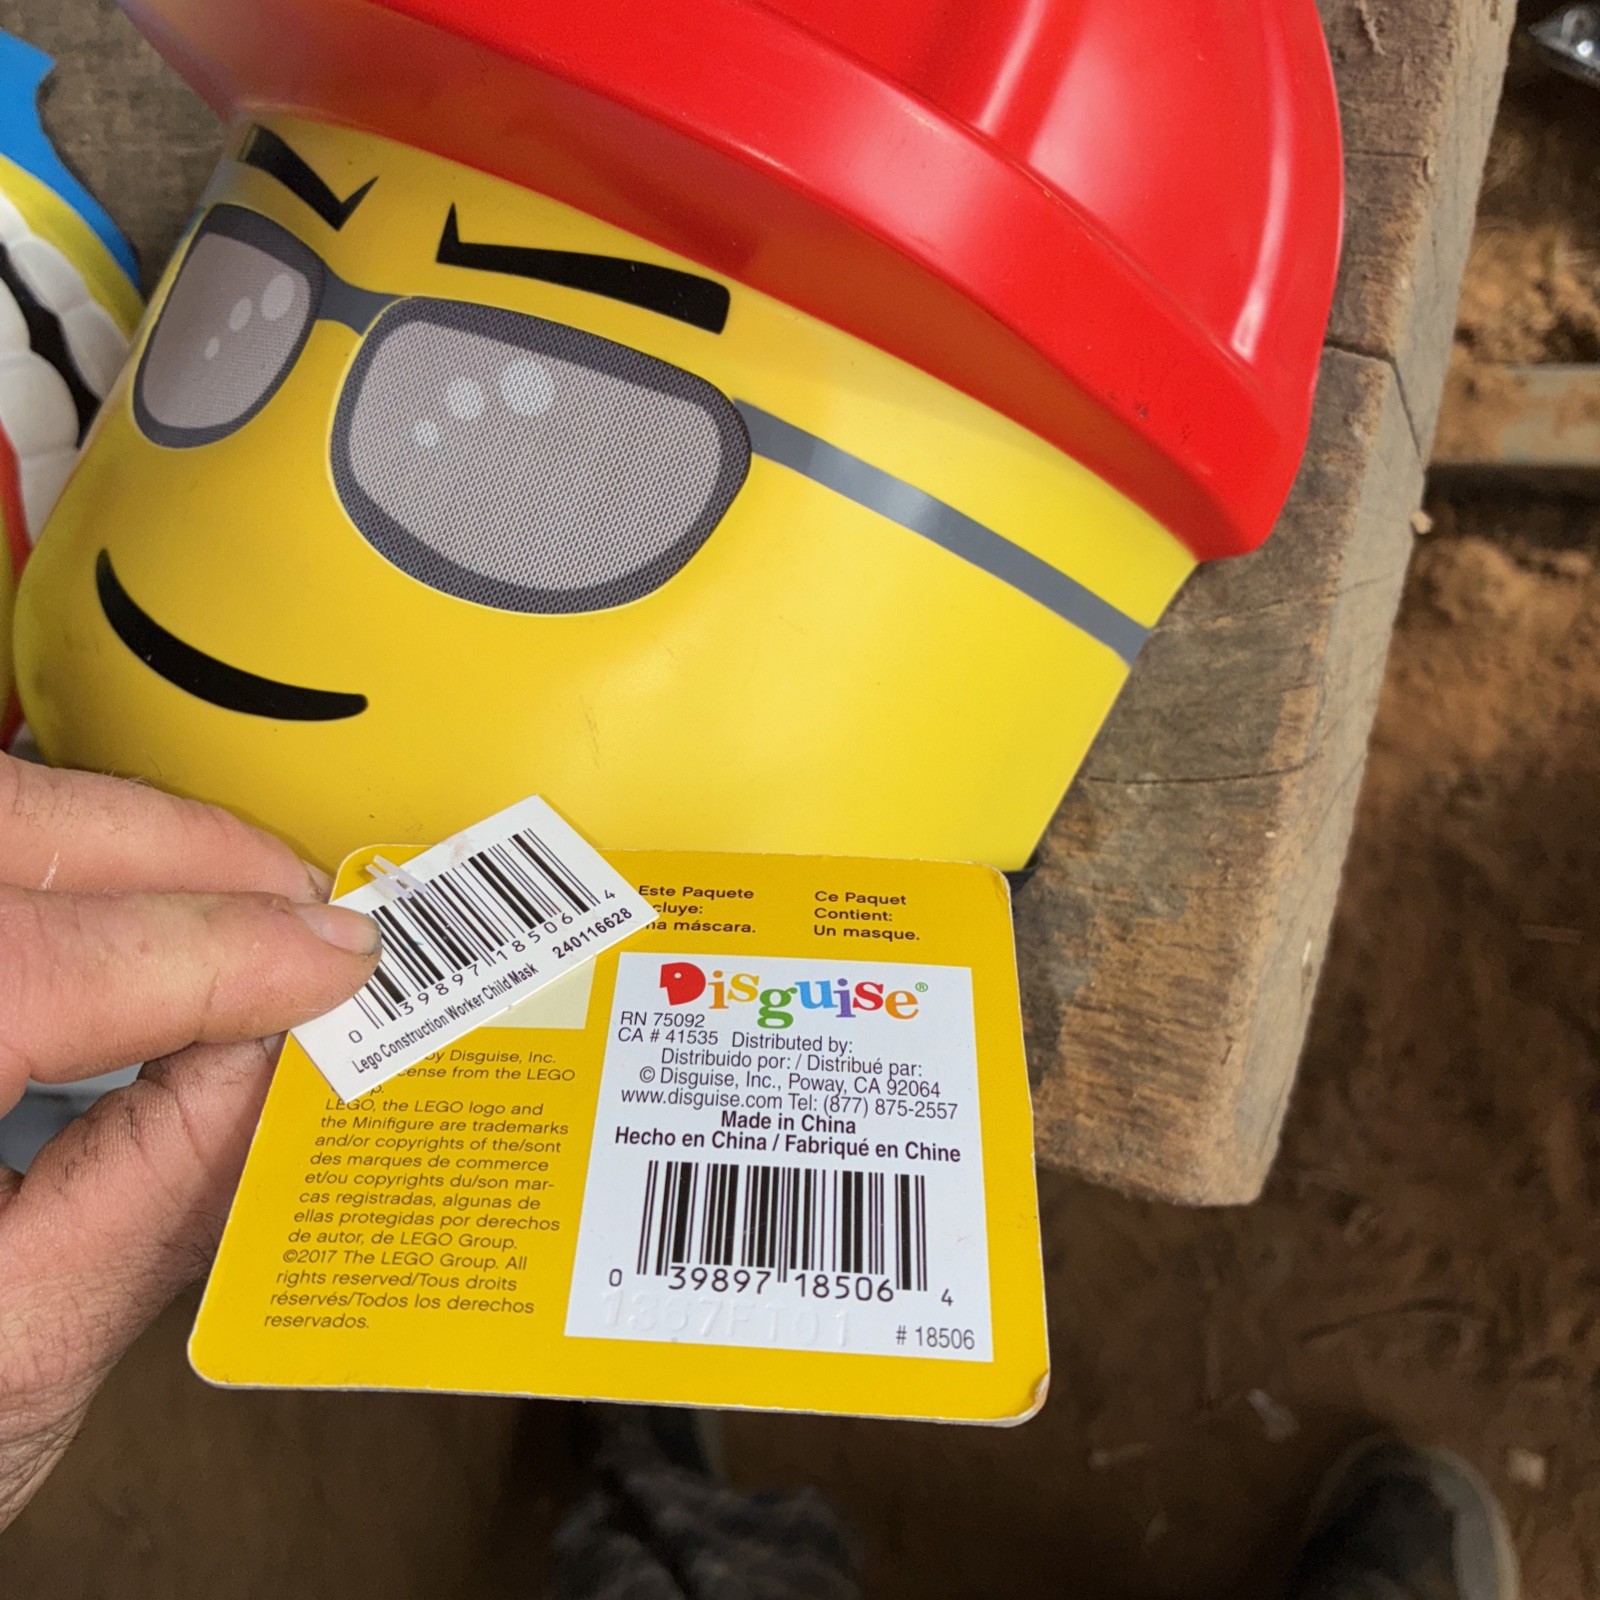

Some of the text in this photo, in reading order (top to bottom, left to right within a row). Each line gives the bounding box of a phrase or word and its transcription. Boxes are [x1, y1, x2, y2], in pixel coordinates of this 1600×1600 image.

[638, 885, 755, 901] Este Paquete
[815, 890, 906, 908] Ce Paquet
[653, 902, 703, 917] cluye:
[815, 908, 892, 922] Contient:
[644, 919, 756, 933] na máscara.
[814, 925, 919, 943] Un masque.
[348, 889, 616, 1043] 0 39897 18506 4
[352, 908, 632, 1074] Lego Construction Worker Child Mask 240116628
[620, 1012, 704, 1028] RN 75092
[619, 1028, 852, 1055] CA # 41535 Distributed by:
[450, 1050, 522, 1066] Disguise,
[529, 1051, 555, 1063] Inc.
[662, 1048, 922, 1080] Distribuido por: / Distribué par:
[452, 1067, 492, 1079] from
[496, 1069, 521, 1080] the
[527, 1070, 575, 1081] LEGO
[639, 1067, 940, 1098] © Disguise, Inc., Poway, CA 92064
[326, 1098, 543, 1117] LEGO, the LEGO logo and
[621, 1088, 958, 1120] www.disguise.com Tel: (877) 875-2557
[321, 1117, 568, 1134] the Minifigure are trademarks
[721, 1111, 856, 1134] Made in China
[315, 1134, 561, 1153] and/or copyrights of the/sont
[615, 1127, 961, 1162] Hecho en China / Fabriqué en Chine
[310, 1153, 549, 1171] des marques de commerce
[305, 1171, 554, 1190] et/ou copyrights du/son mar-
[300, 1192, 540, 1210] cas registradas, algunas de
[294, 1210, 560, 1231] ellas protegidas por derechos
[288, 1230, 517, 1252] de autor, de LEGO Group.
[283, 1250, 527, 1270] ©2017 The LEGO Group. All
[277, 1270, 517, 1291] rights reserved/Tous droits
[608, 1266, 953, 1306] 0 39897 18506 4
[271, 1292, 534, 1313] réservés/Todos los derechos
[264, 1314, 370, 1329] reservados.
[896, 1326, 974, 1350] # 18506
